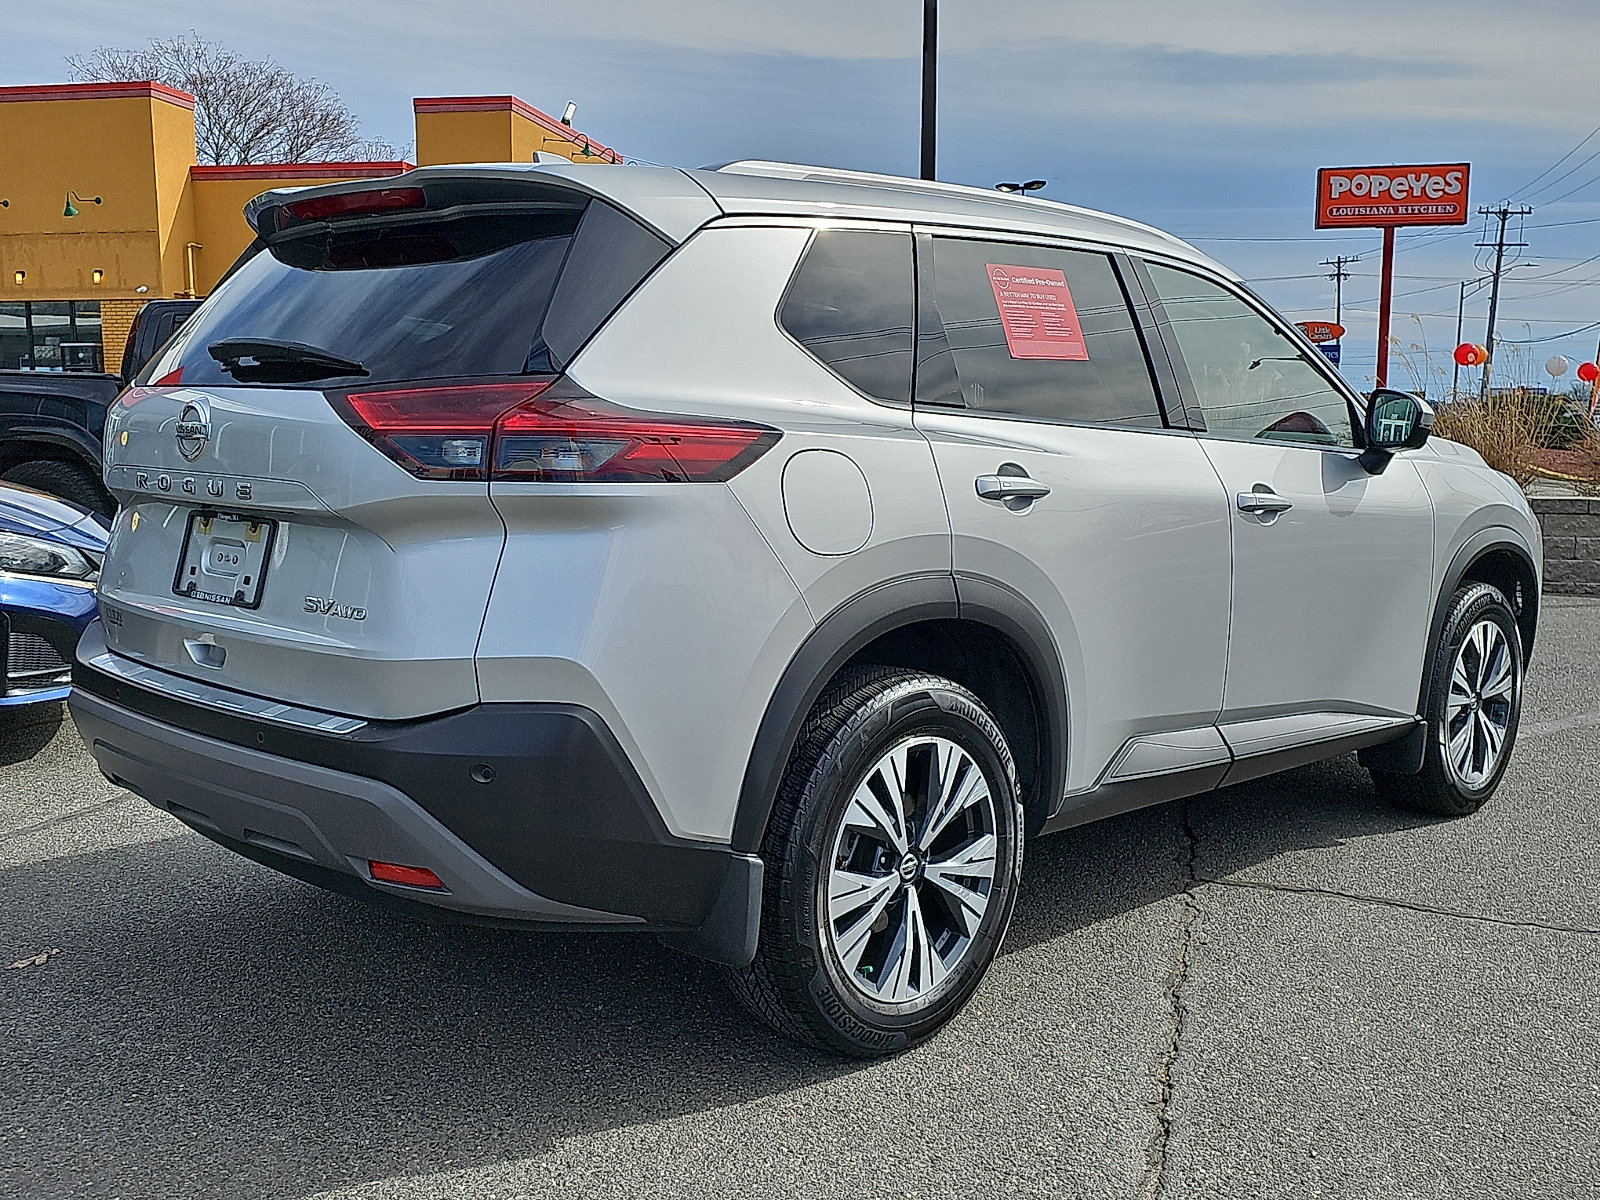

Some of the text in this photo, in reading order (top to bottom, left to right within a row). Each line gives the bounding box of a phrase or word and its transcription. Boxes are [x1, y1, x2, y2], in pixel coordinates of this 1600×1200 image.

[1332, 204, 1454, 216] LOUISIANA KITCHEN
[1012, 276, 1064, 287] Certified Pre-Owned
[1314, 326, 1331, 334] Little
[176, 424, 202, 435] NISSAN
[135, 472, 253, 500] ROGUE
[204, 593, 231, 604] NISSAN
[303, 596, 368, 621] SV AWD
[947, 697, 1015, 771] BRIDGESTONE
[817, 985, 899, 1048] BRIDGESTONE
